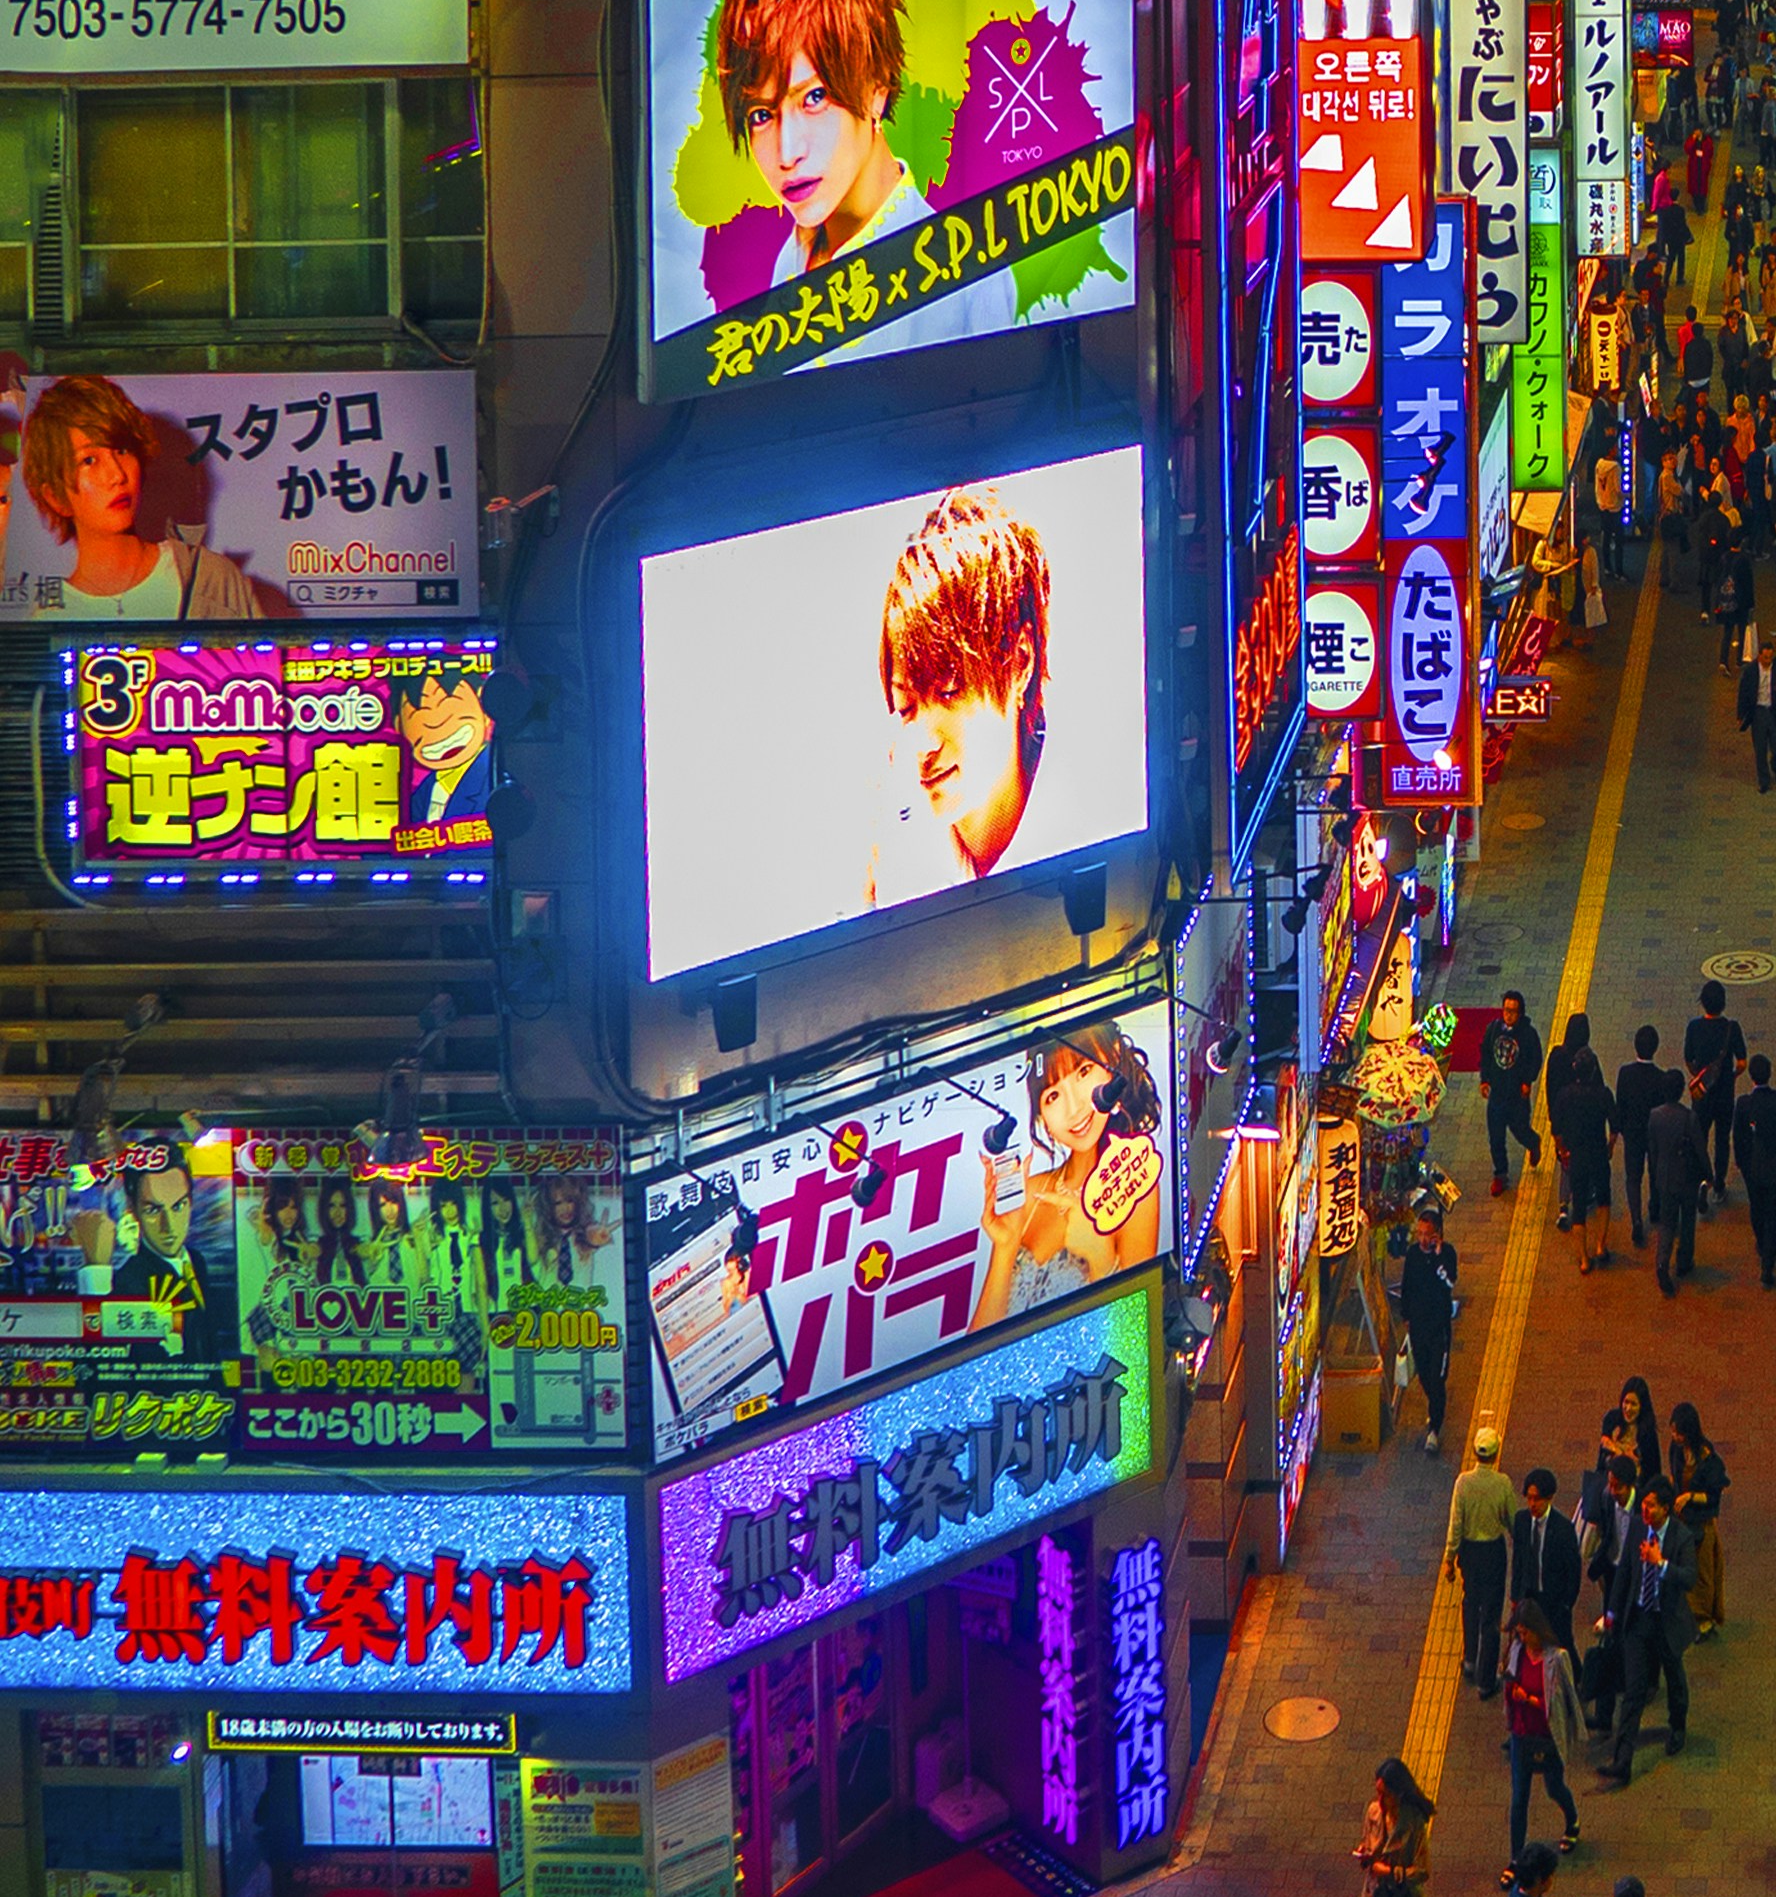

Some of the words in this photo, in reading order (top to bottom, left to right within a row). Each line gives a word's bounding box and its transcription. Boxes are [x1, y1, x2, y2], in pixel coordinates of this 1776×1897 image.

[1315, 51, 1402, 82] 오른쪽
[1585, 20, 1618, 165] ルノアール
[1303, 91, 1358, 121] 대각선
[1369, 89, 1413, 121] 뒤로!
[1002, 146, 1042, 163] TOKYO
[1458, 65, 1521, 327] にいむら
[706, 259, 884, 386] 君の太陽
[1006, 143, 1133, 246] TOKYO
[1525, 273, 1550, 479] カワノ・クォーク
[184, 390, 384, 467] スタプロ
[277, 445, 454, 520] かもん!
[287, 542, 456, 575] MixChannel
[325, 586, 378, 600] ミクチャ
[423, 584, 453, 601] 検索
[1402, 571, 1454, 736] たばこ
[1391, 764, 1462, 792] 直売所
[872, 1052, 1043, 1135] ナビゲーション!
[647, 1136, 822, 1221] 歌舞伎町安心
[1090, 1145, 1153, 1213] 女の子ブログ
[1098, 1147, 1133, 1186] 全国の
[117, 1311, 157, 1331] 検索
[295, 1291, 406, 1328] LOVE
[515, 1310, 620, 1349] 2,000円
[300, 1360, 461, 1387] 03-3232-2888
[91, 1390, 236, 1440] リクポケ
[248, 1401, 432, 1445] ここから30秒
[716, 1355, 1129, 1632] 無料案内所
[114, 1552, 597, 1669] 無料案内所
[1111, 1536, 1170, 1851] 無料案内所
